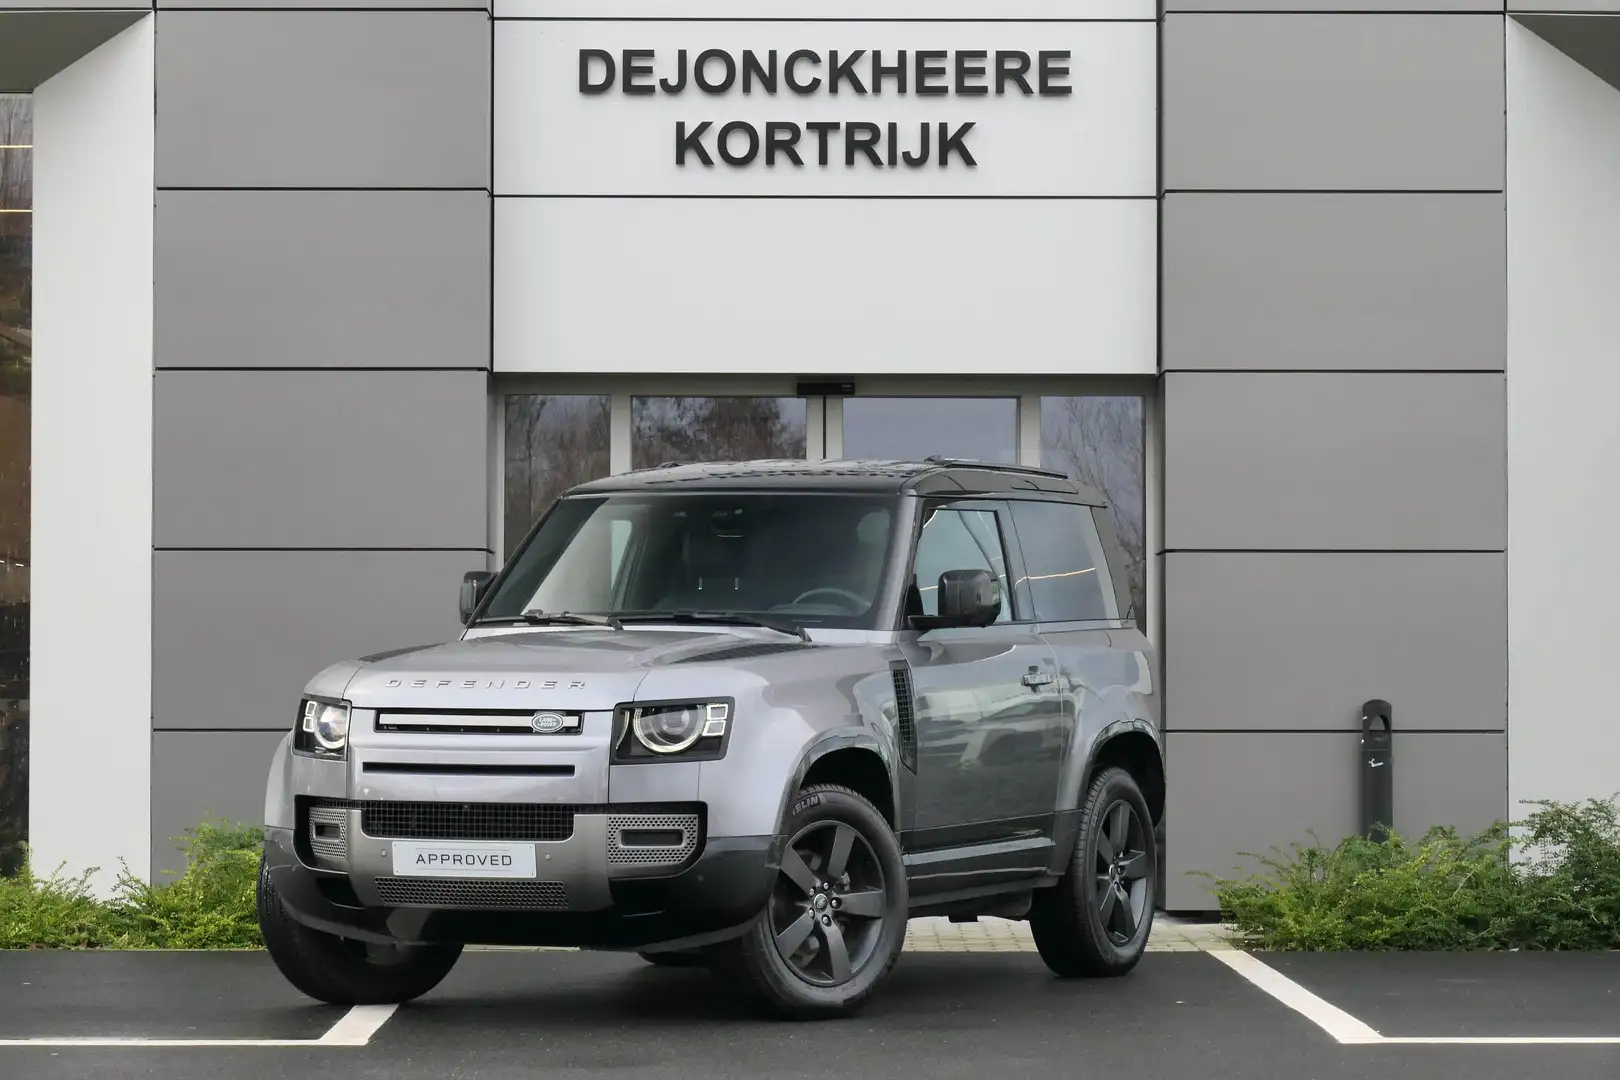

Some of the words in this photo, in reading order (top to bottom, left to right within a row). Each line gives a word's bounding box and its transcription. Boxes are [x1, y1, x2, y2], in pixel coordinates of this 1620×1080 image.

[578, 48, 1073, 96] DEJONCKHEERE
[675, 120, 977, 167] KORTRIJK
[384, 679, 586, 690] DEFENDER
[415, 853, 512, 866] APPROVED
